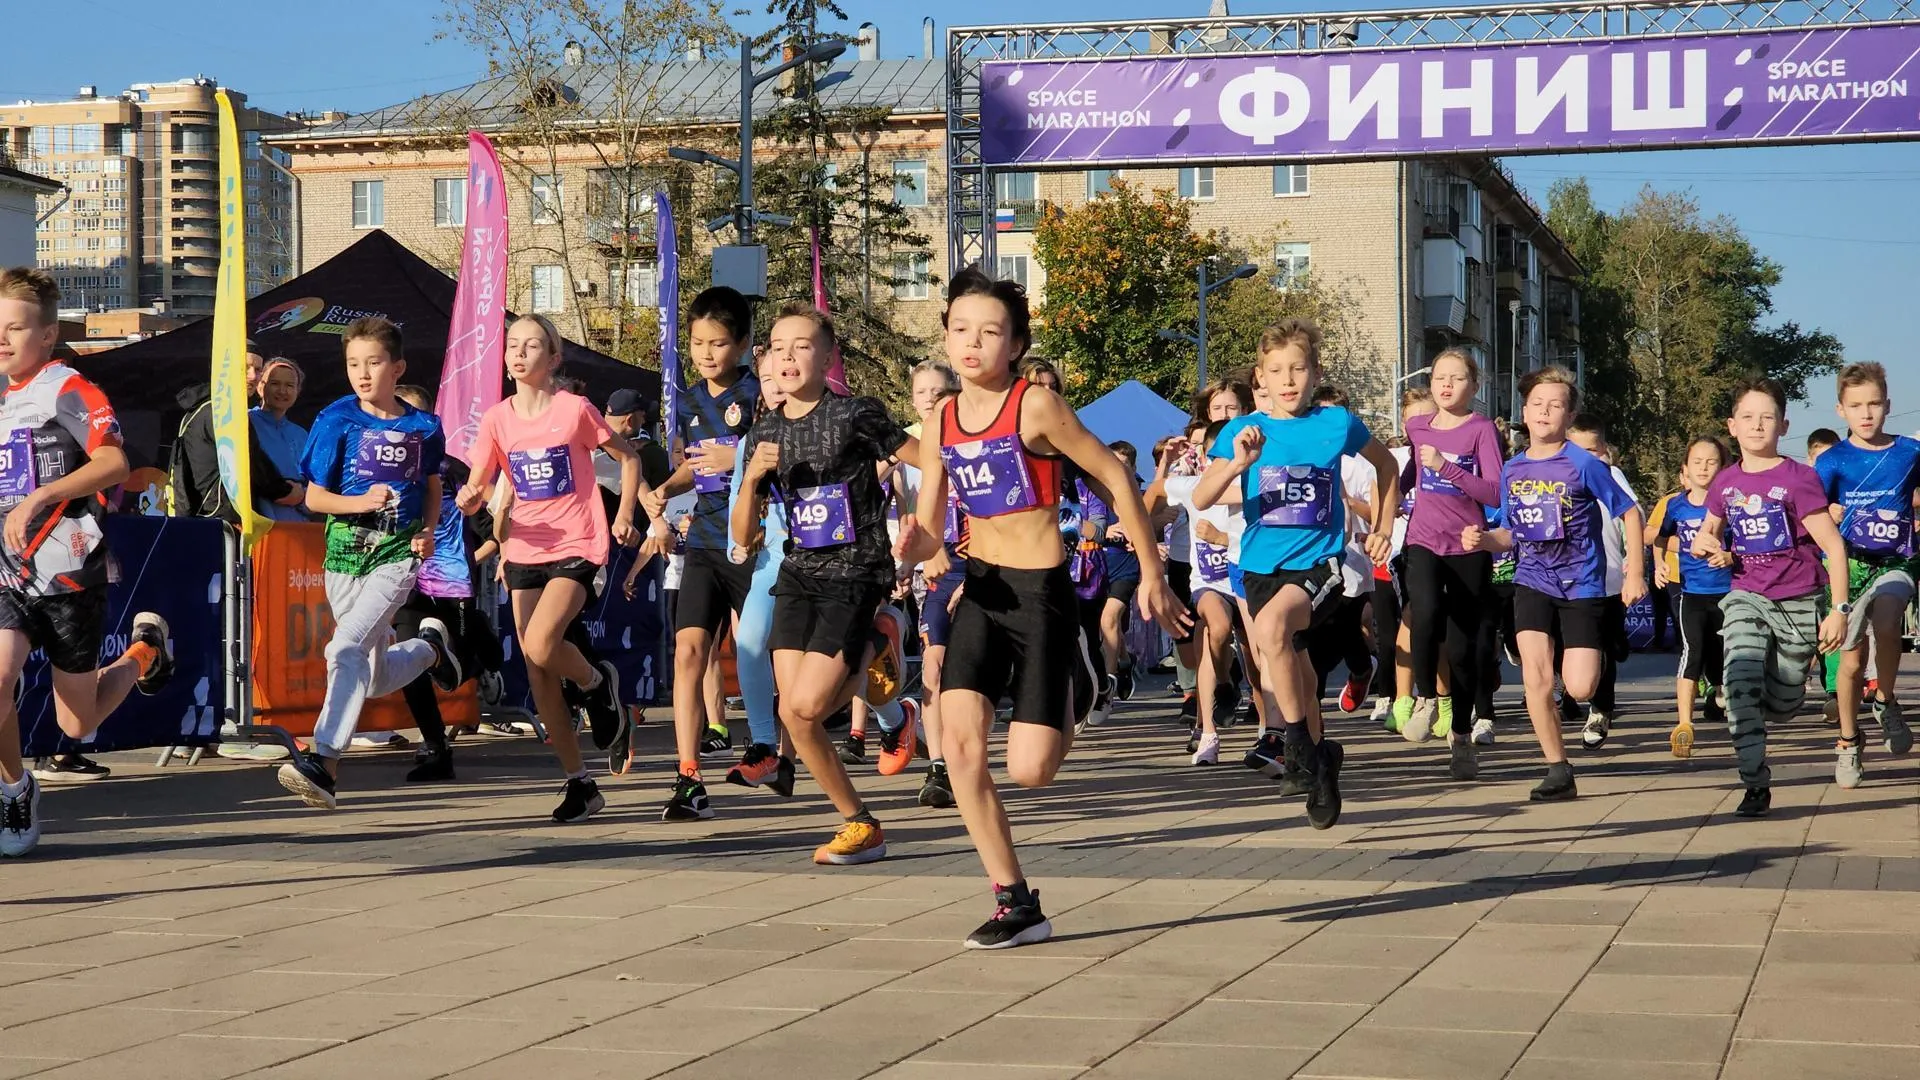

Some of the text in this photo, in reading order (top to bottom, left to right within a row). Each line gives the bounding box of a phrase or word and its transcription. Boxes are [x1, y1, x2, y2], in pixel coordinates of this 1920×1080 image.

[1766, 58, 1847, 80] SPACE
[1026, 89, 1097, 108] SPACE
[1218, 47, 1708, 146] ФИНИШ
[374, 444, 407, 463] 139
[521, 461, 554, 481] 155
[955, 461, 996, 489] 114
[1276, 482, 1316, 502] 153
[793, 504, 828, 525] 149
[1517, 507, 1544, 524] 132
[1684, 529, 1698, 542] 10
[1739, 517, 1770, 536] 135
[1867, 521, 1900, 539] 108
[288, 568, 325, 592] Эффек
[1625, 603, 1653, 614] ACE
